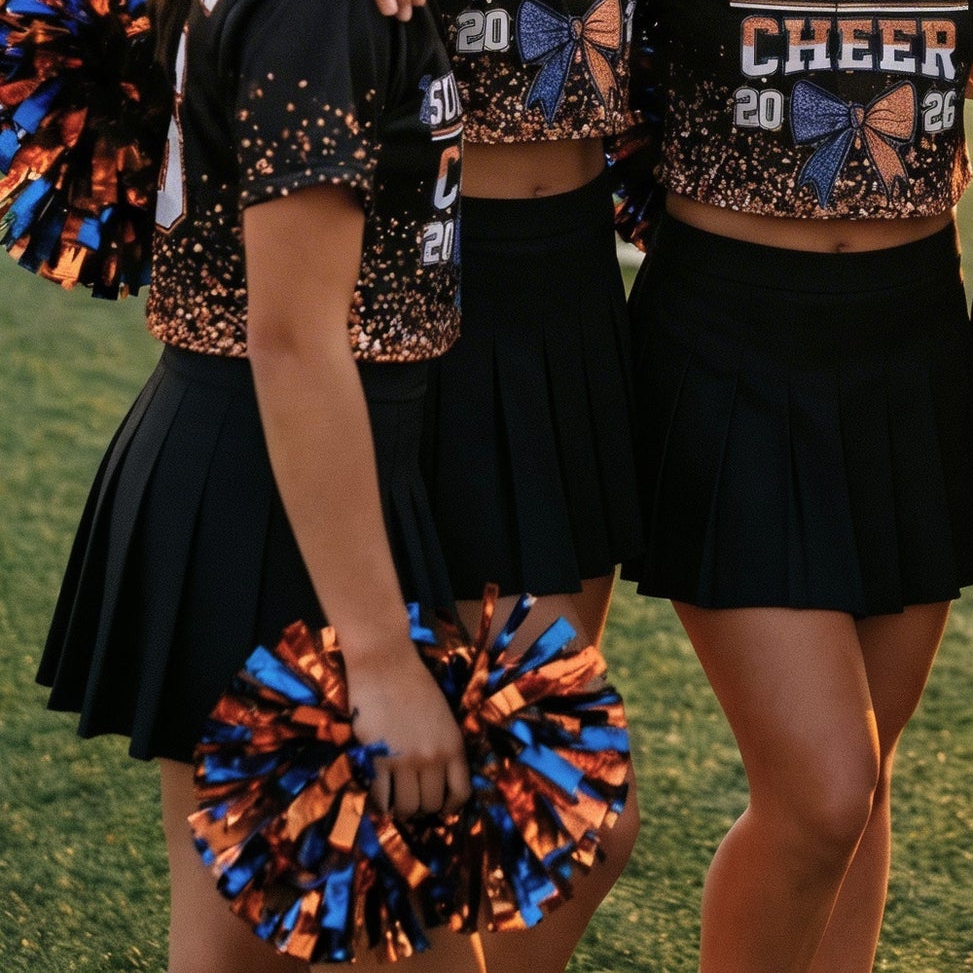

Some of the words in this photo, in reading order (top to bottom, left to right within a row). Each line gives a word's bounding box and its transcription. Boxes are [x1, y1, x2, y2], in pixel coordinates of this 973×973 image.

[456, 8, 510, 53] 20
[740, 14, 957, 80] CHEER
[733, 86, 784, 131] 20
[922, 88, 957, 133] 26
